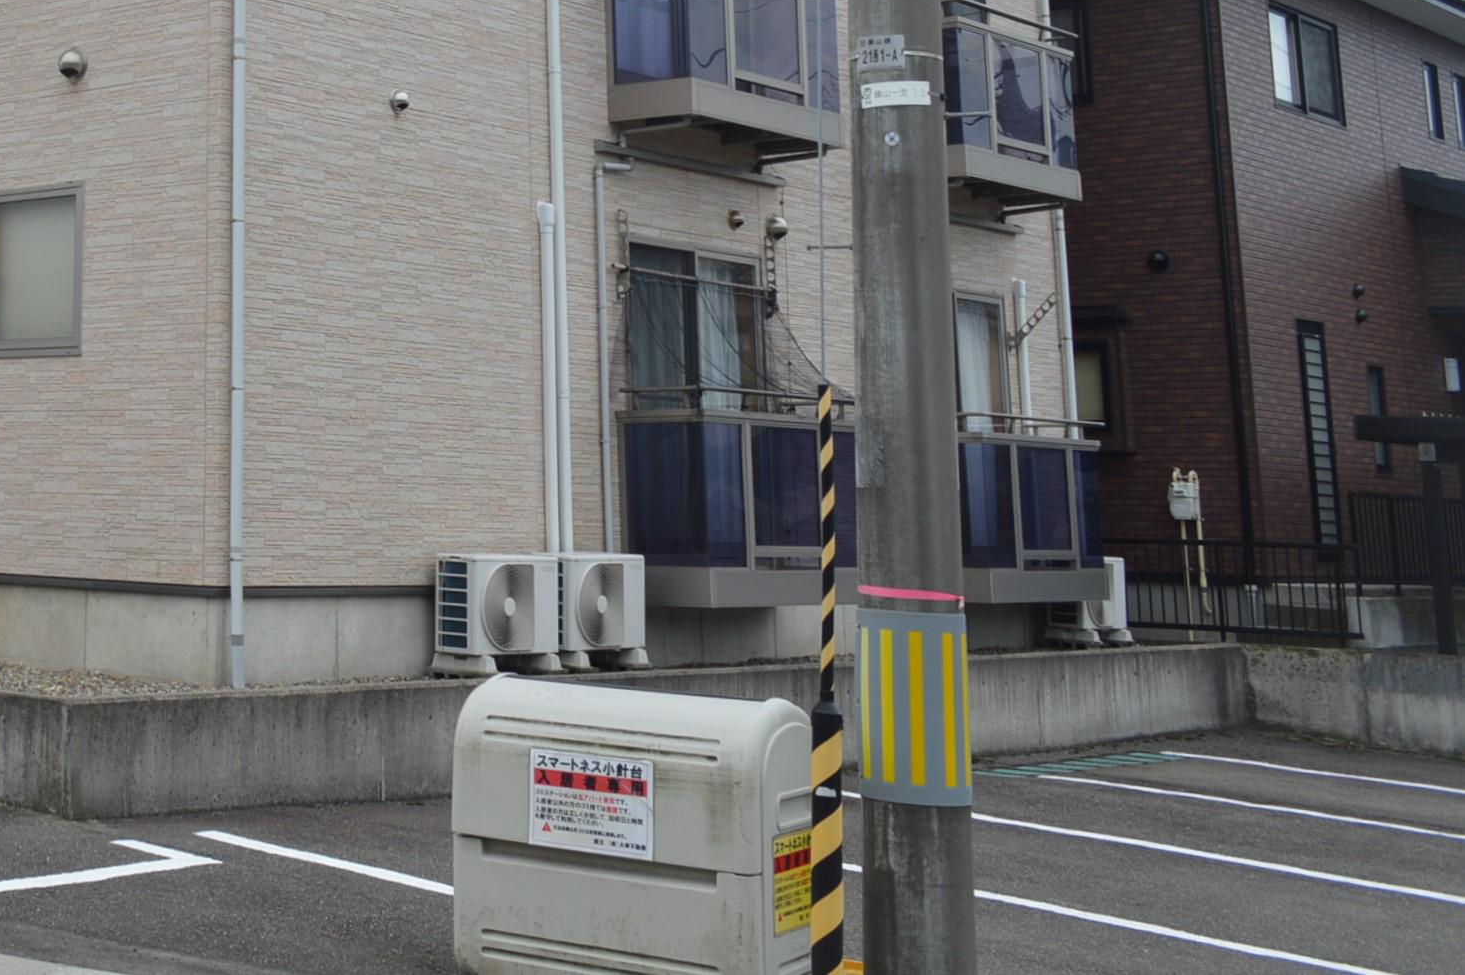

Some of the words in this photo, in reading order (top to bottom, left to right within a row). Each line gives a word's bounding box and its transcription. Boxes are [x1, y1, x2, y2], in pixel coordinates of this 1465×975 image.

[536, 754, 643, 780] スマートネス小針台
